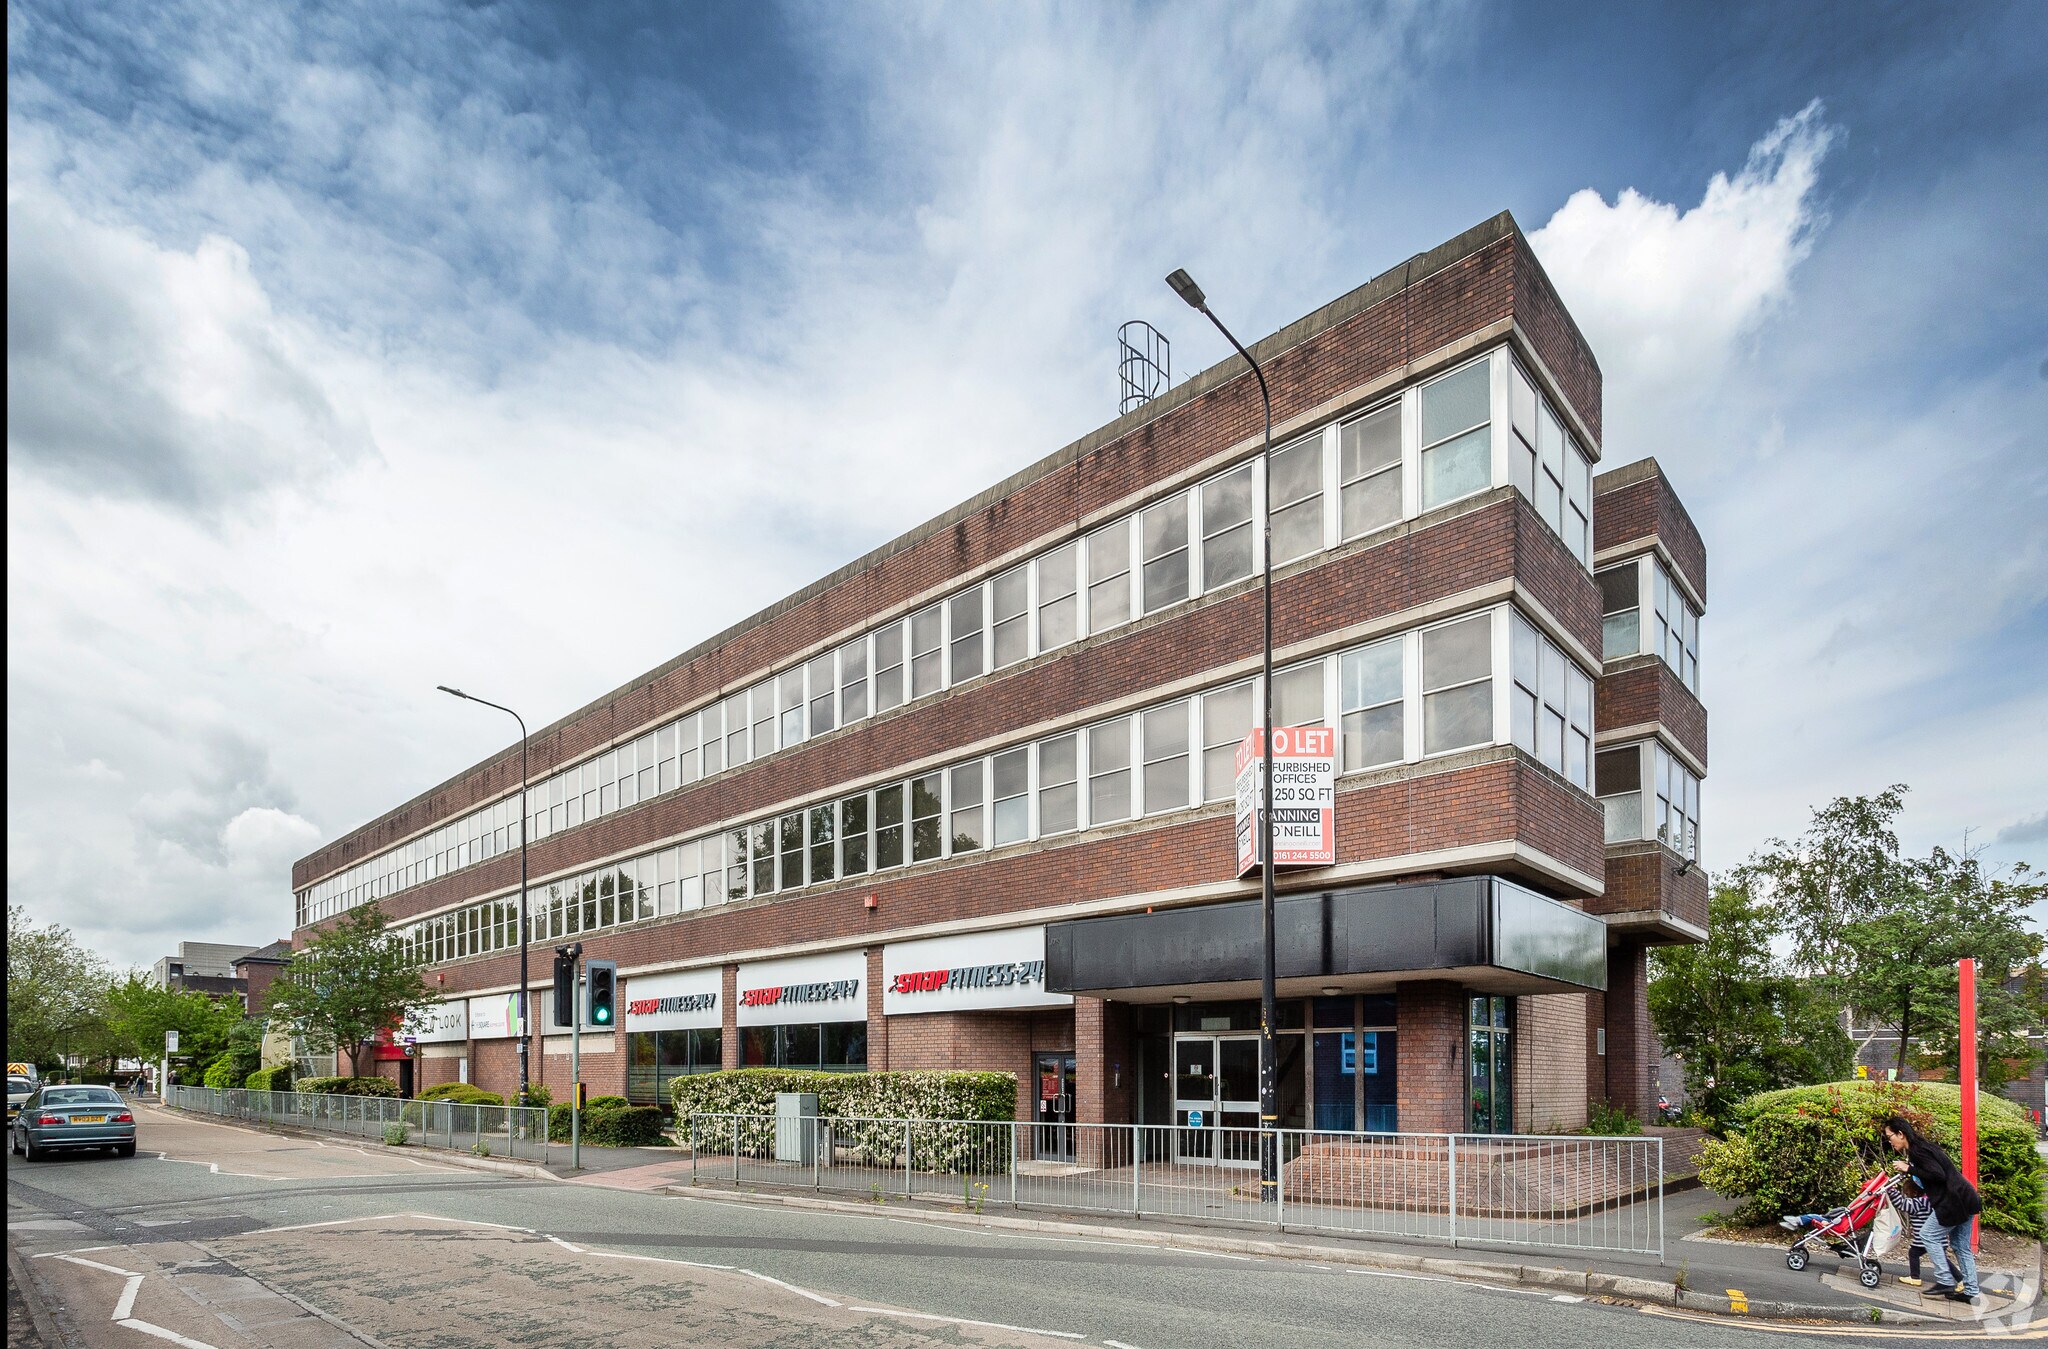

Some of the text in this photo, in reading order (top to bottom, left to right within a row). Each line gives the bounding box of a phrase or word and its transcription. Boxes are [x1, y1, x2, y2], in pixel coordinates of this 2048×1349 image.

[1295, 730, 1329, 754] LET
[1259, 762, 1331, 773] RFURBISHED
[1273, 773, 1317, 784] OFFICES
[1298, 788, 1315, 801] SQ
[1318, 788, 1332, 801] FT
[1272, 825, 1321, 837] O'NEILL
[1273, 851, 1331, 860] 0161 244 5500
[439, 1013, 462, 1029] LOOK
